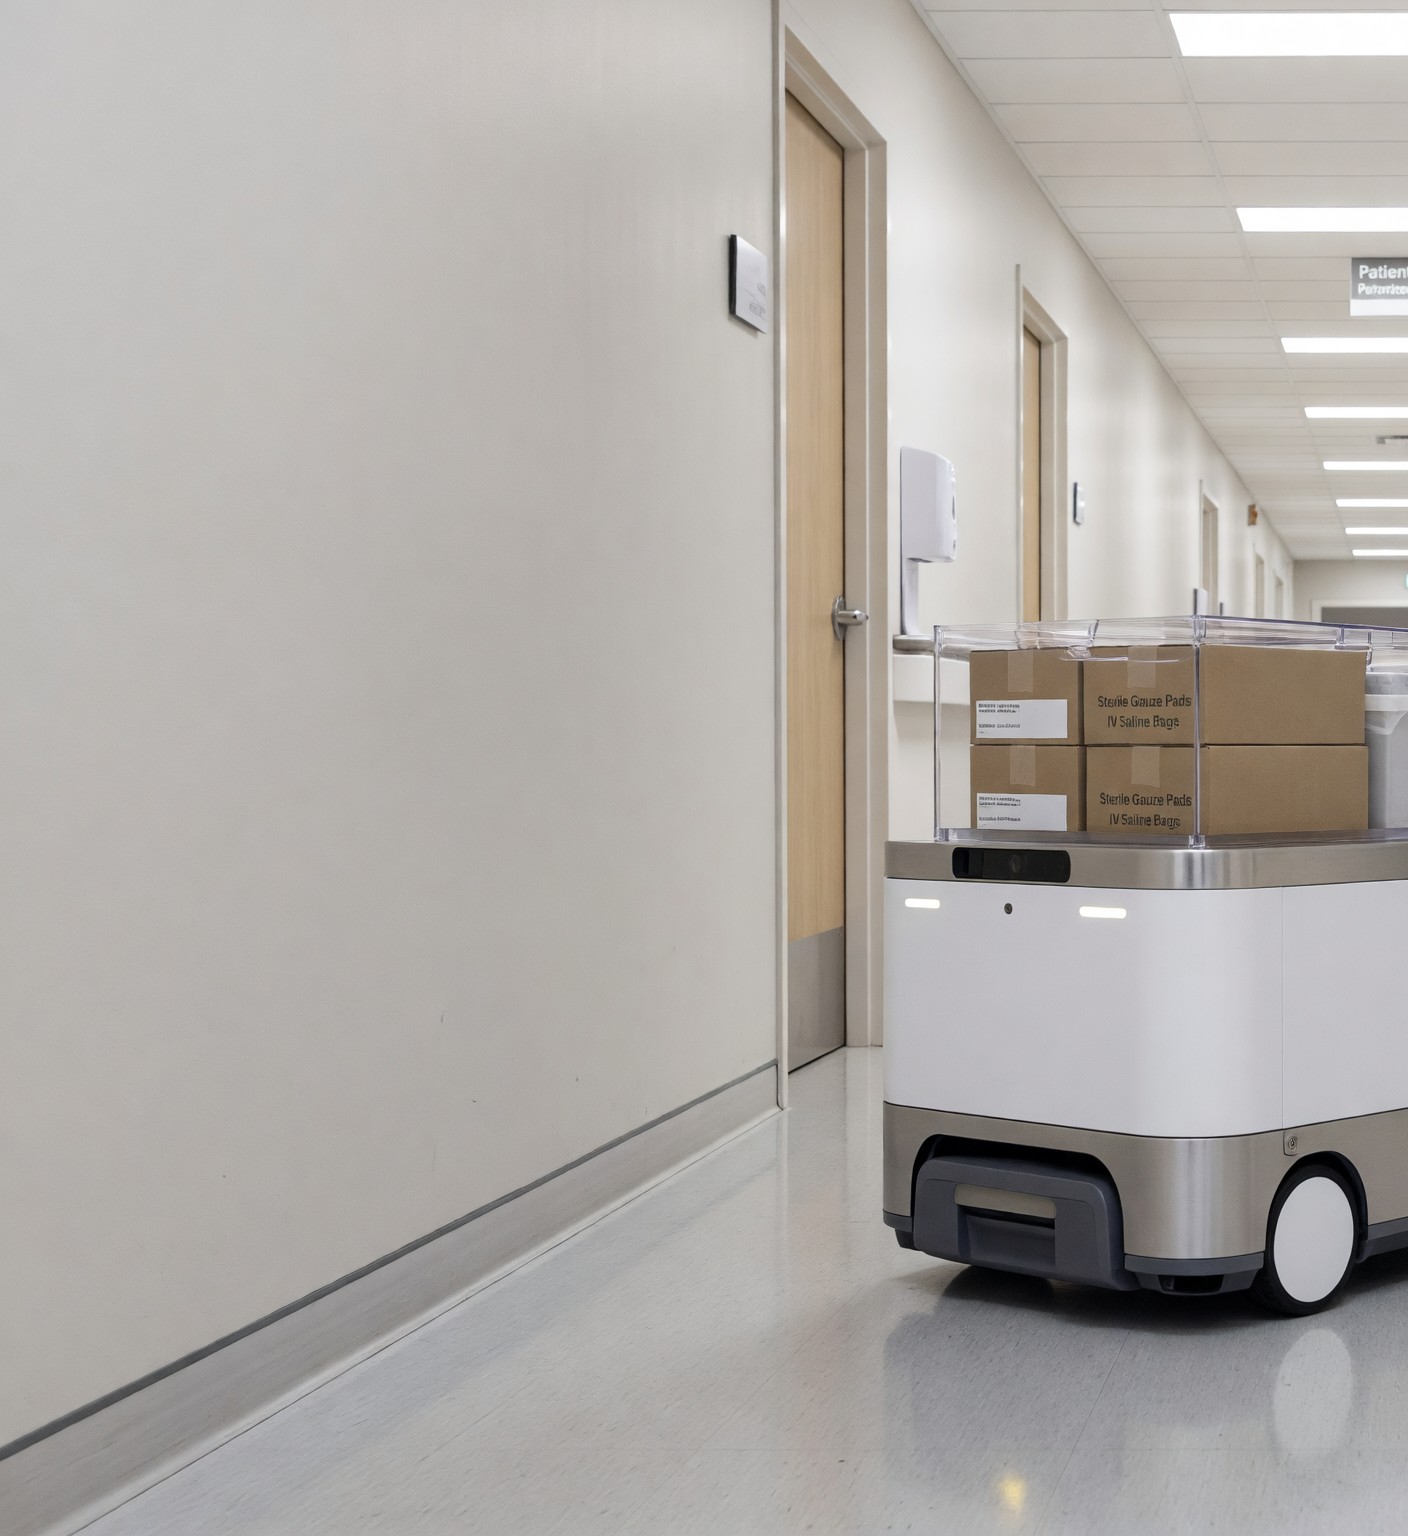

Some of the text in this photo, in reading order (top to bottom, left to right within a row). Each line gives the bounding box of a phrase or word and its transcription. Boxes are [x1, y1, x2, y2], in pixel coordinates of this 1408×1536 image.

[1165, 694, 1192, 707] Pads
[1107, 715, 1118, 728] IV
[1166, 793, 1192, 806] Pads
[1109, 813, 1120, 825] IV
